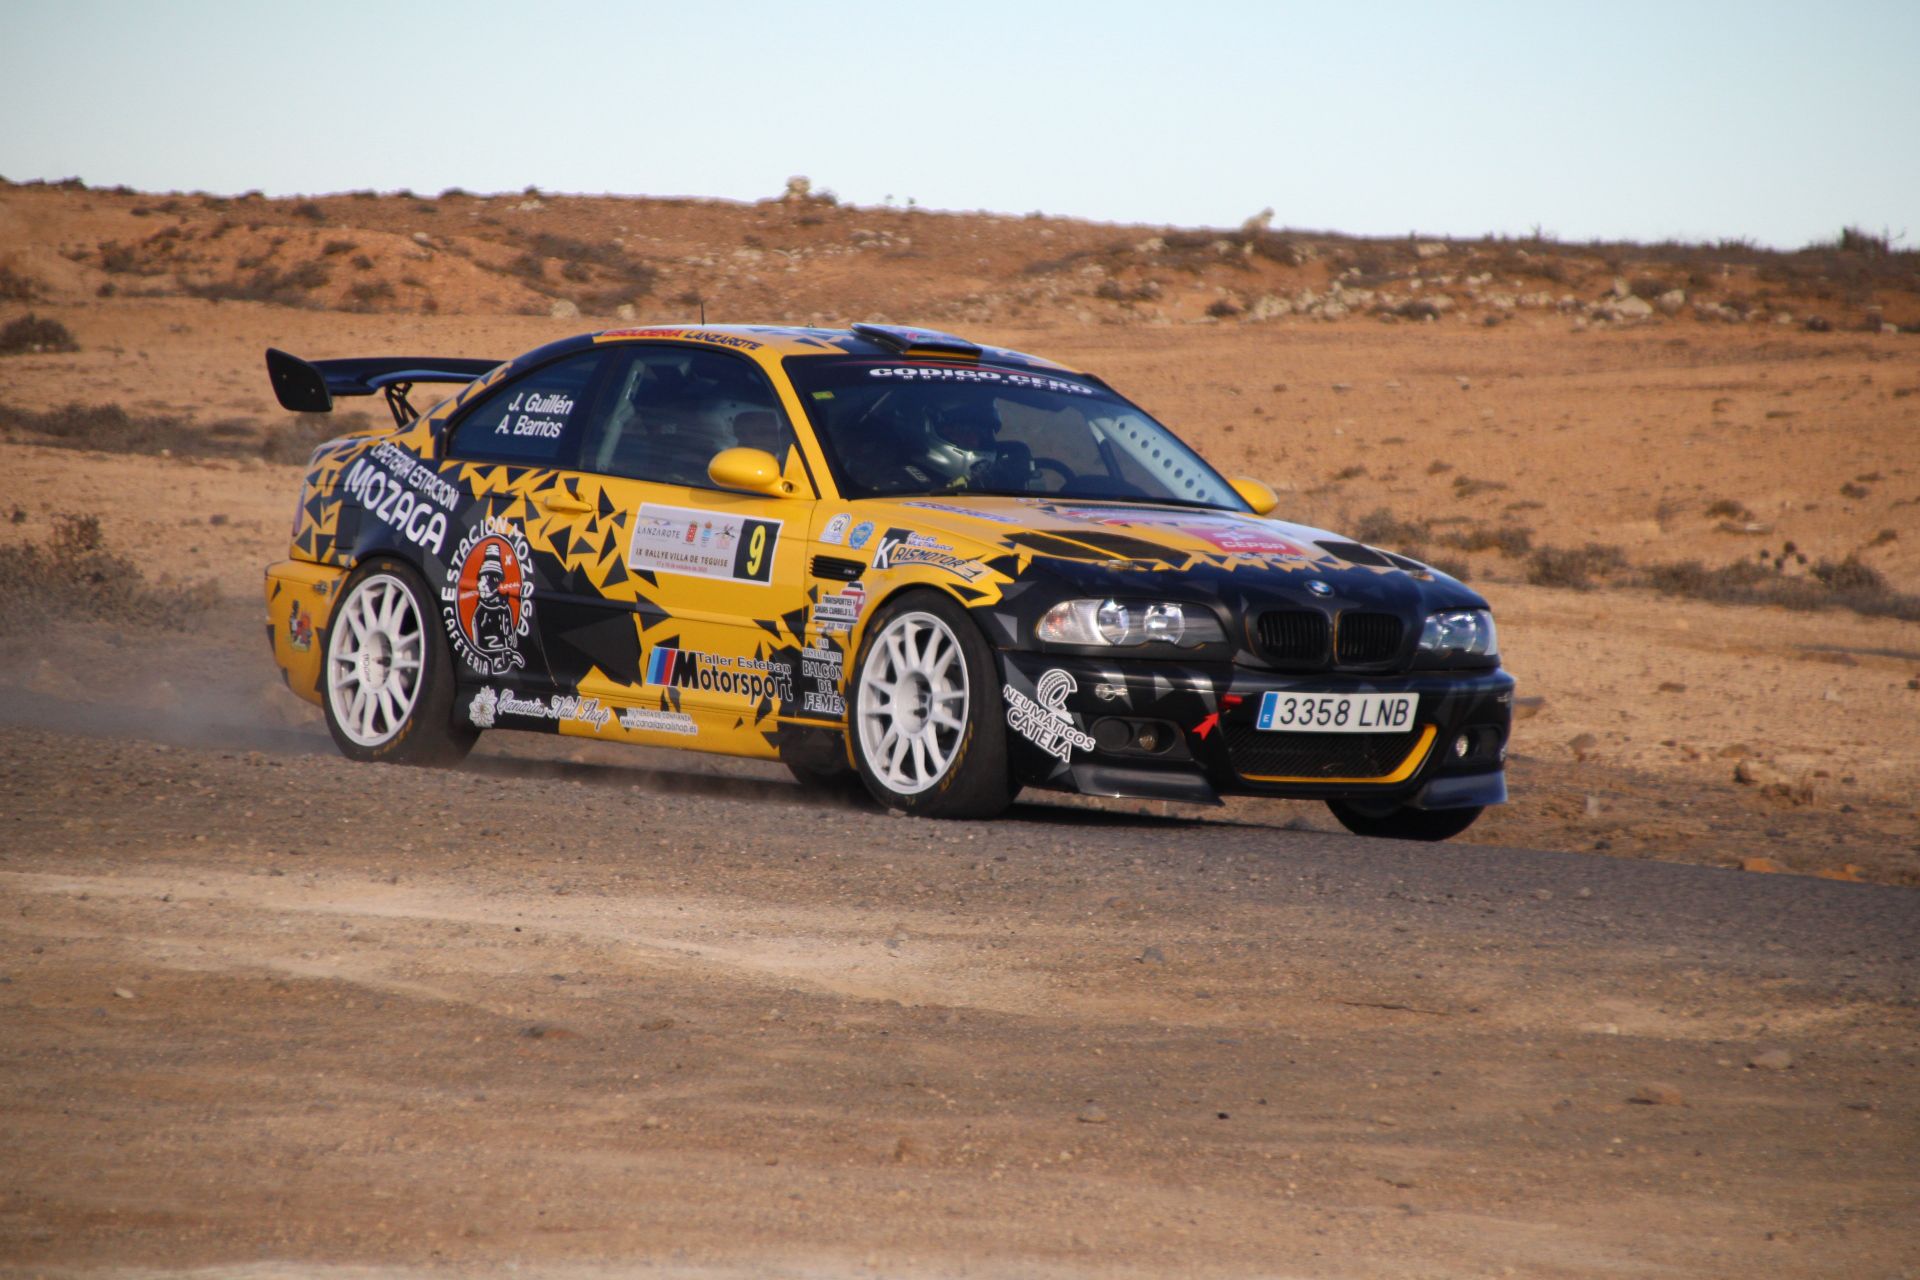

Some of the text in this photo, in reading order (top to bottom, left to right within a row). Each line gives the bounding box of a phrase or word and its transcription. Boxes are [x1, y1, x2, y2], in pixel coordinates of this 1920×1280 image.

[684, 331, 763, 350] LANZAROTE
[869, 367, 1093, 395] CODIGO CERO
[508, 392, 574, 415] J. Guillén
[495, 414, 563, 438] A. Barrios
[370, 440, 459, 511] CAFETERIA ESTACION
[637, 525, 681, 540] LANZAROTE
[746, 525, 766, 576] 9
[1222, 540, 1287, 551] CEPSA
[441, 515, 508, 602] ESTACION
[645, 549, 668, 559] RALLYE
[669, 552, 688, 562] VILLA
[690, 555, 699, 563] DE
[701, 556, 728, 567] TEGUISE
[443, 606, 489, 676] CAFETERIA
[697, 652, 792, 674] Taller Esteban
[802, 660, 843, 680] BALCÓN
[670, 649, 793, 706] Motorsport
[818, 679, 832, 695] DE
[497, 689, 611, 732] Canarias Nail Shop
[804, 691, 846, 715] FEMÉS
[1263, 698, 1410, 727] E 3358 LNB
[1007, 706, 1072, 763] CATELA
